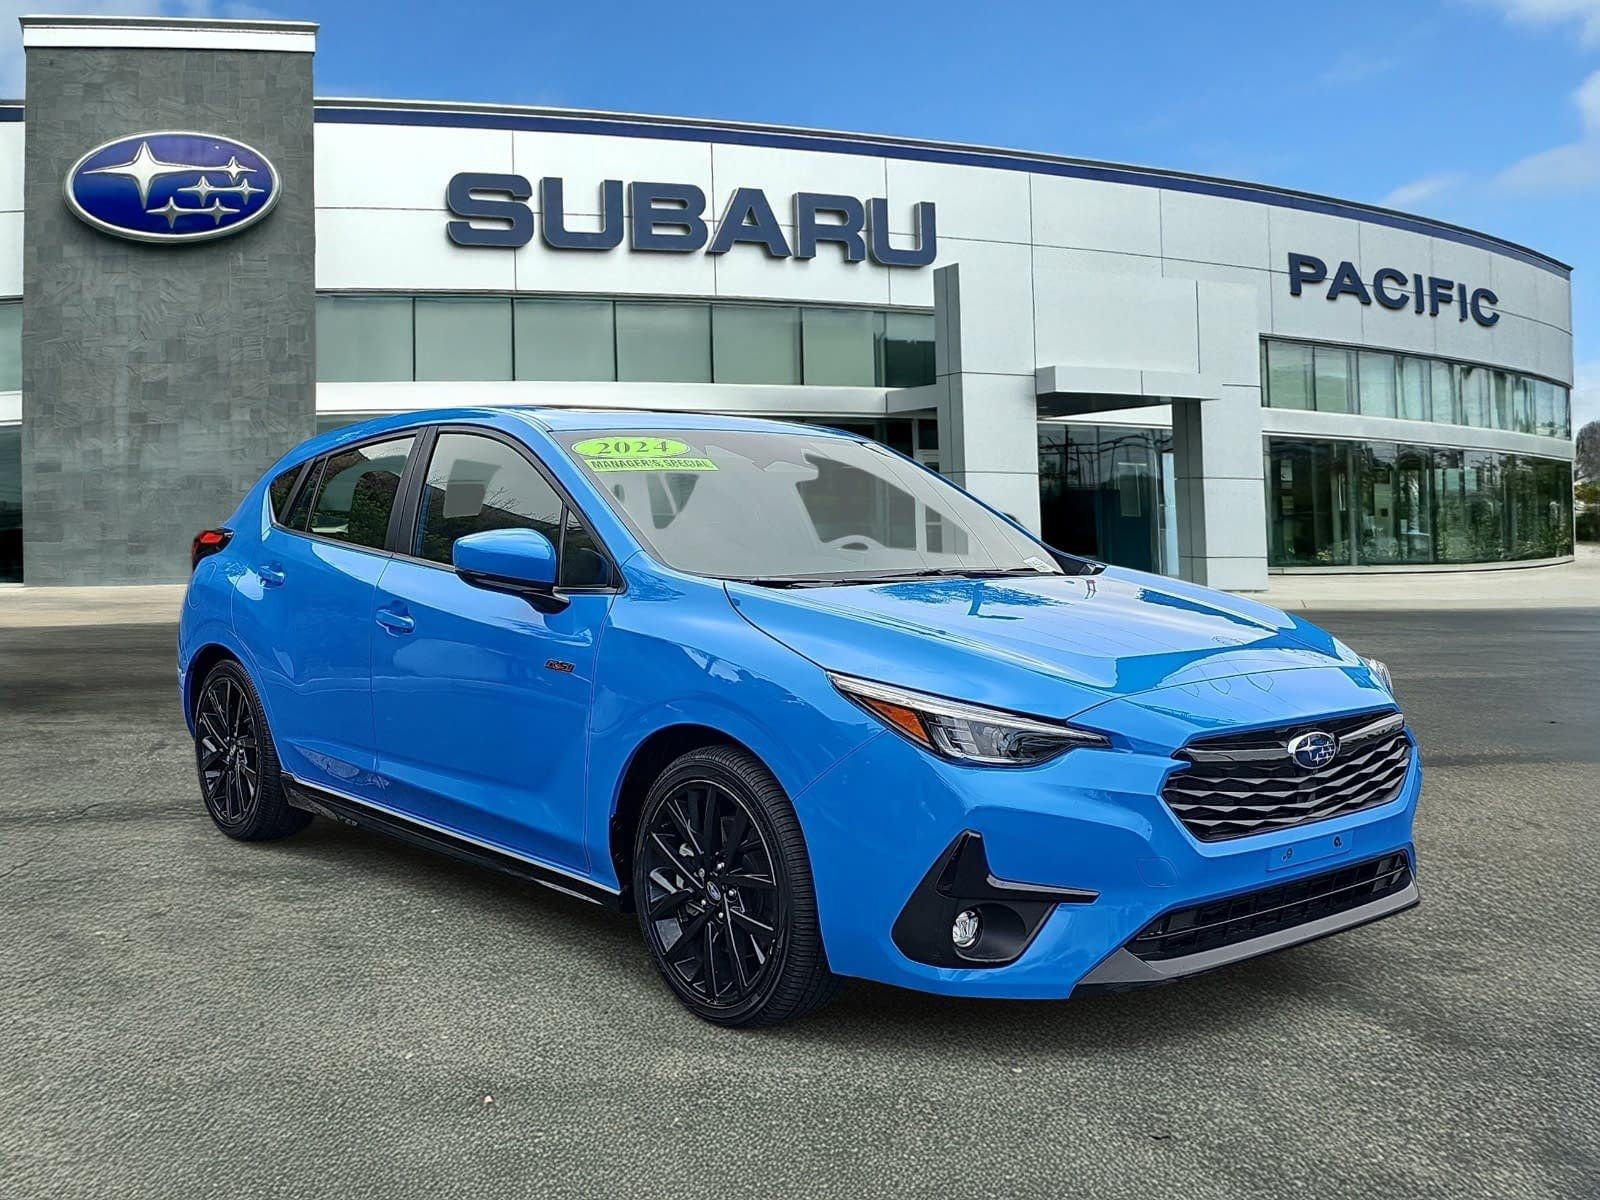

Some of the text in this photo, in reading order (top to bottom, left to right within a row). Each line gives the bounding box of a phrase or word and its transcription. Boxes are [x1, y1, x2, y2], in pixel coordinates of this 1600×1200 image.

[447, 172, 937, 267] SUBARU
[1288, 252, 1500, 327] PACIFIC
[591, 459, 714, 469] MANAGER'S SPECIAL
[598, 441, 669, 454] 2024
